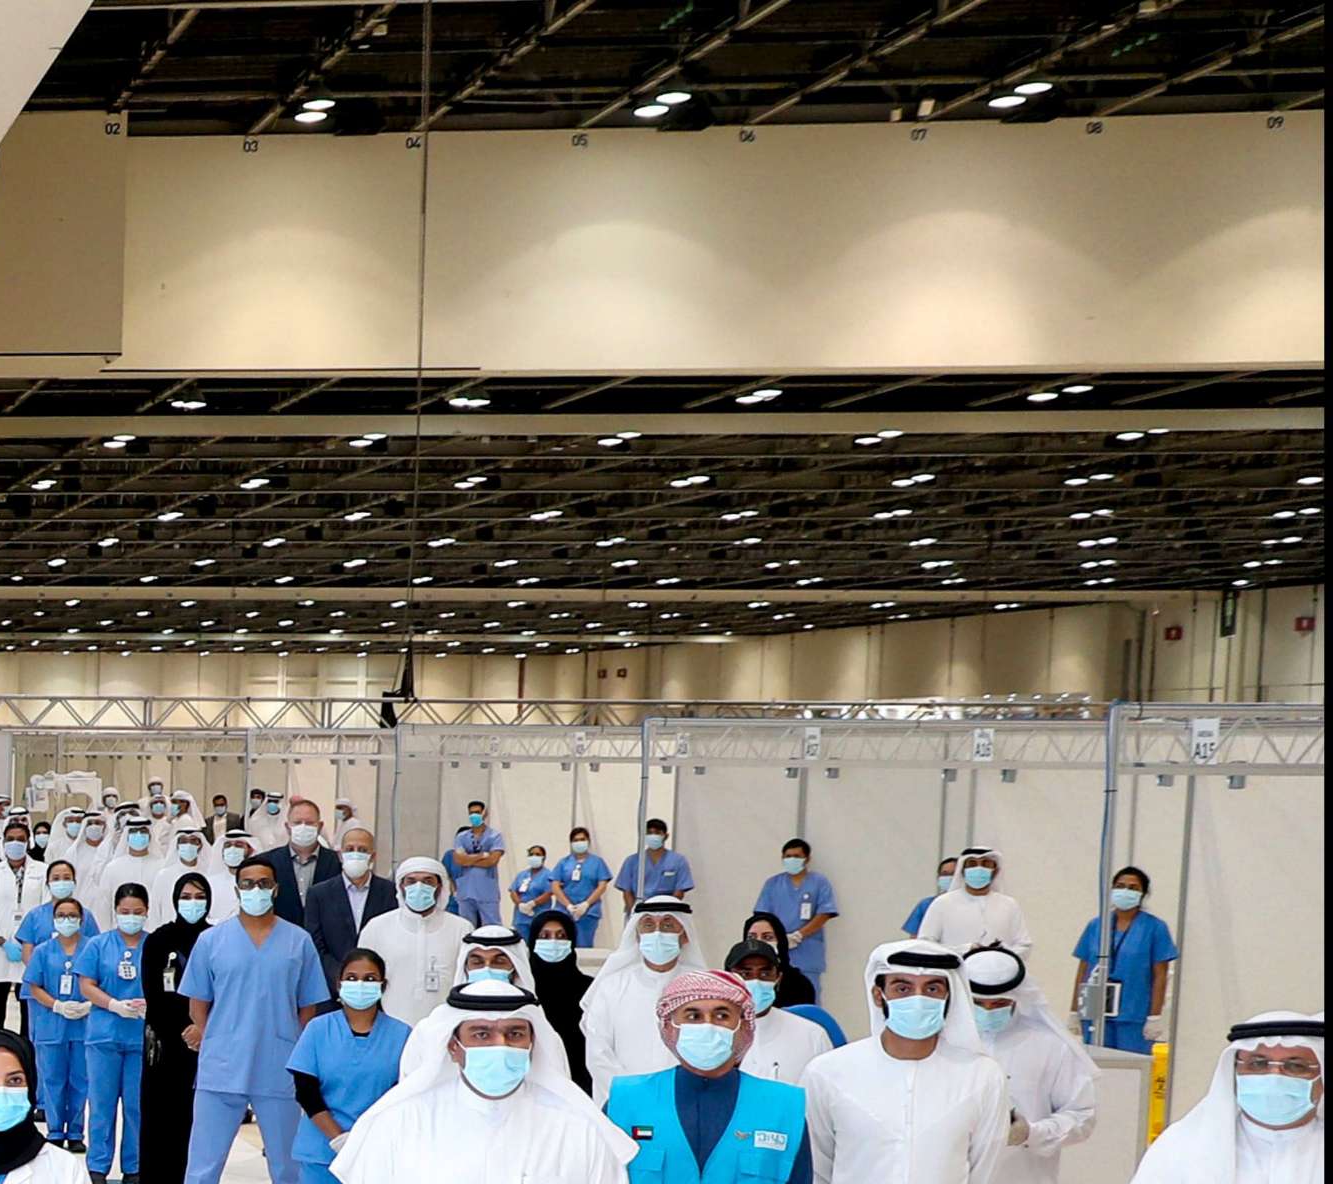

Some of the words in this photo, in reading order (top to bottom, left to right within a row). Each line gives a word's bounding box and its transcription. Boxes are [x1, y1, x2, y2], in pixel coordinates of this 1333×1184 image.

[105, 123, 121, 135] 02
[1267, 116, 1283, 129] 09
[572, 134, 588, 148] 05
[739, 130, 755, 143] 06
[910, 128, 927, 141] 07
[243, 140, 258, 152] 03
[405, 137, 421, 149] 04
